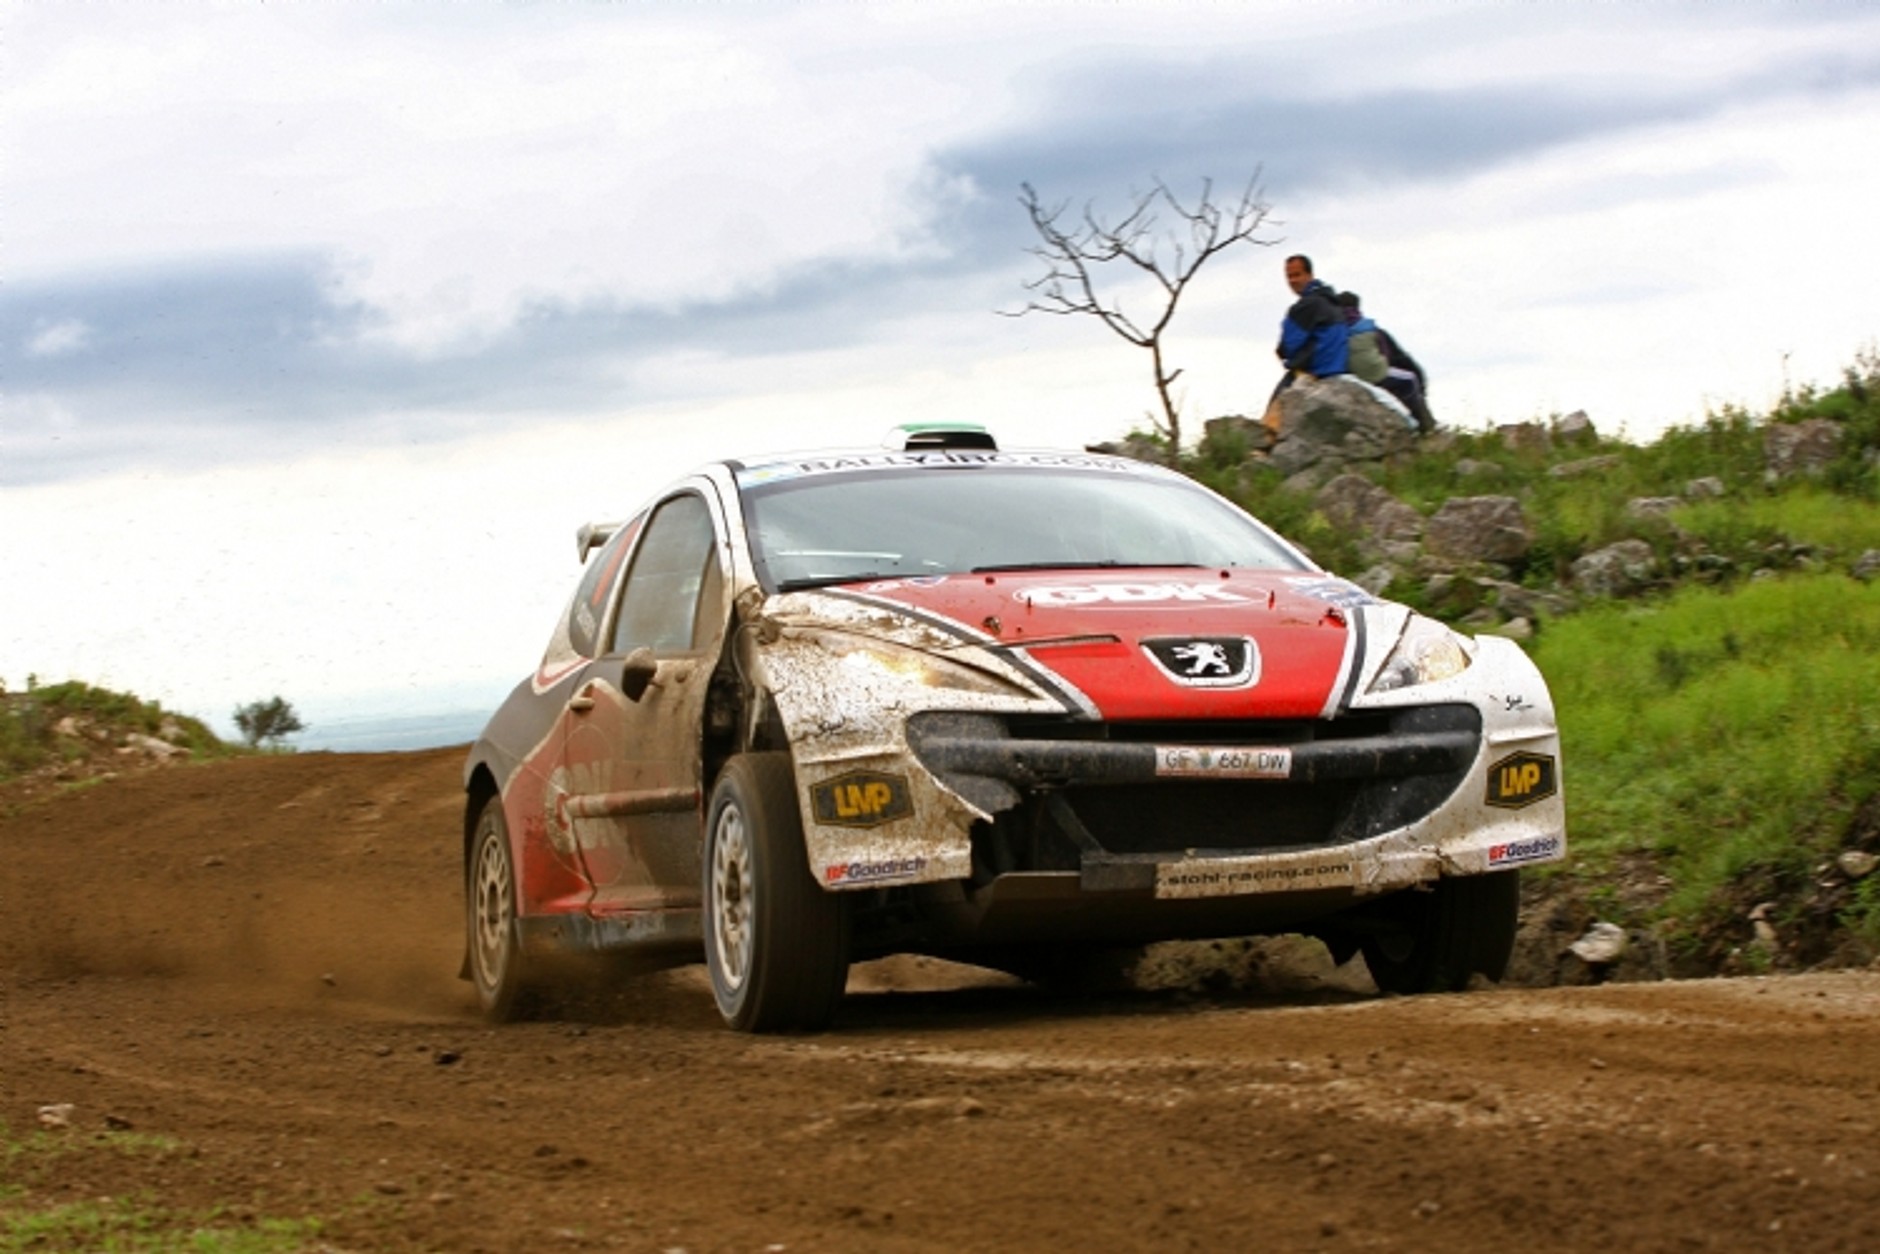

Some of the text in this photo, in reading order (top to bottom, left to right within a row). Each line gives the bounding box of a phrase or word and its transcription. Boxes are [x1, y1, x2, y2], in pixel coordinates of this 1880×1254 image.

[1022, 583, 1250, 607] GDK
[1218, 752, 1252, 769] 667
[1258, 753, 1286, 769] DW
[1501, 762, 1541, 797] LMP
[834, 782, 892, 817] LMP
[1489, 837, 1558, 862] BFGoodrich
[826, 856, 927, 881] BFGoodrich
